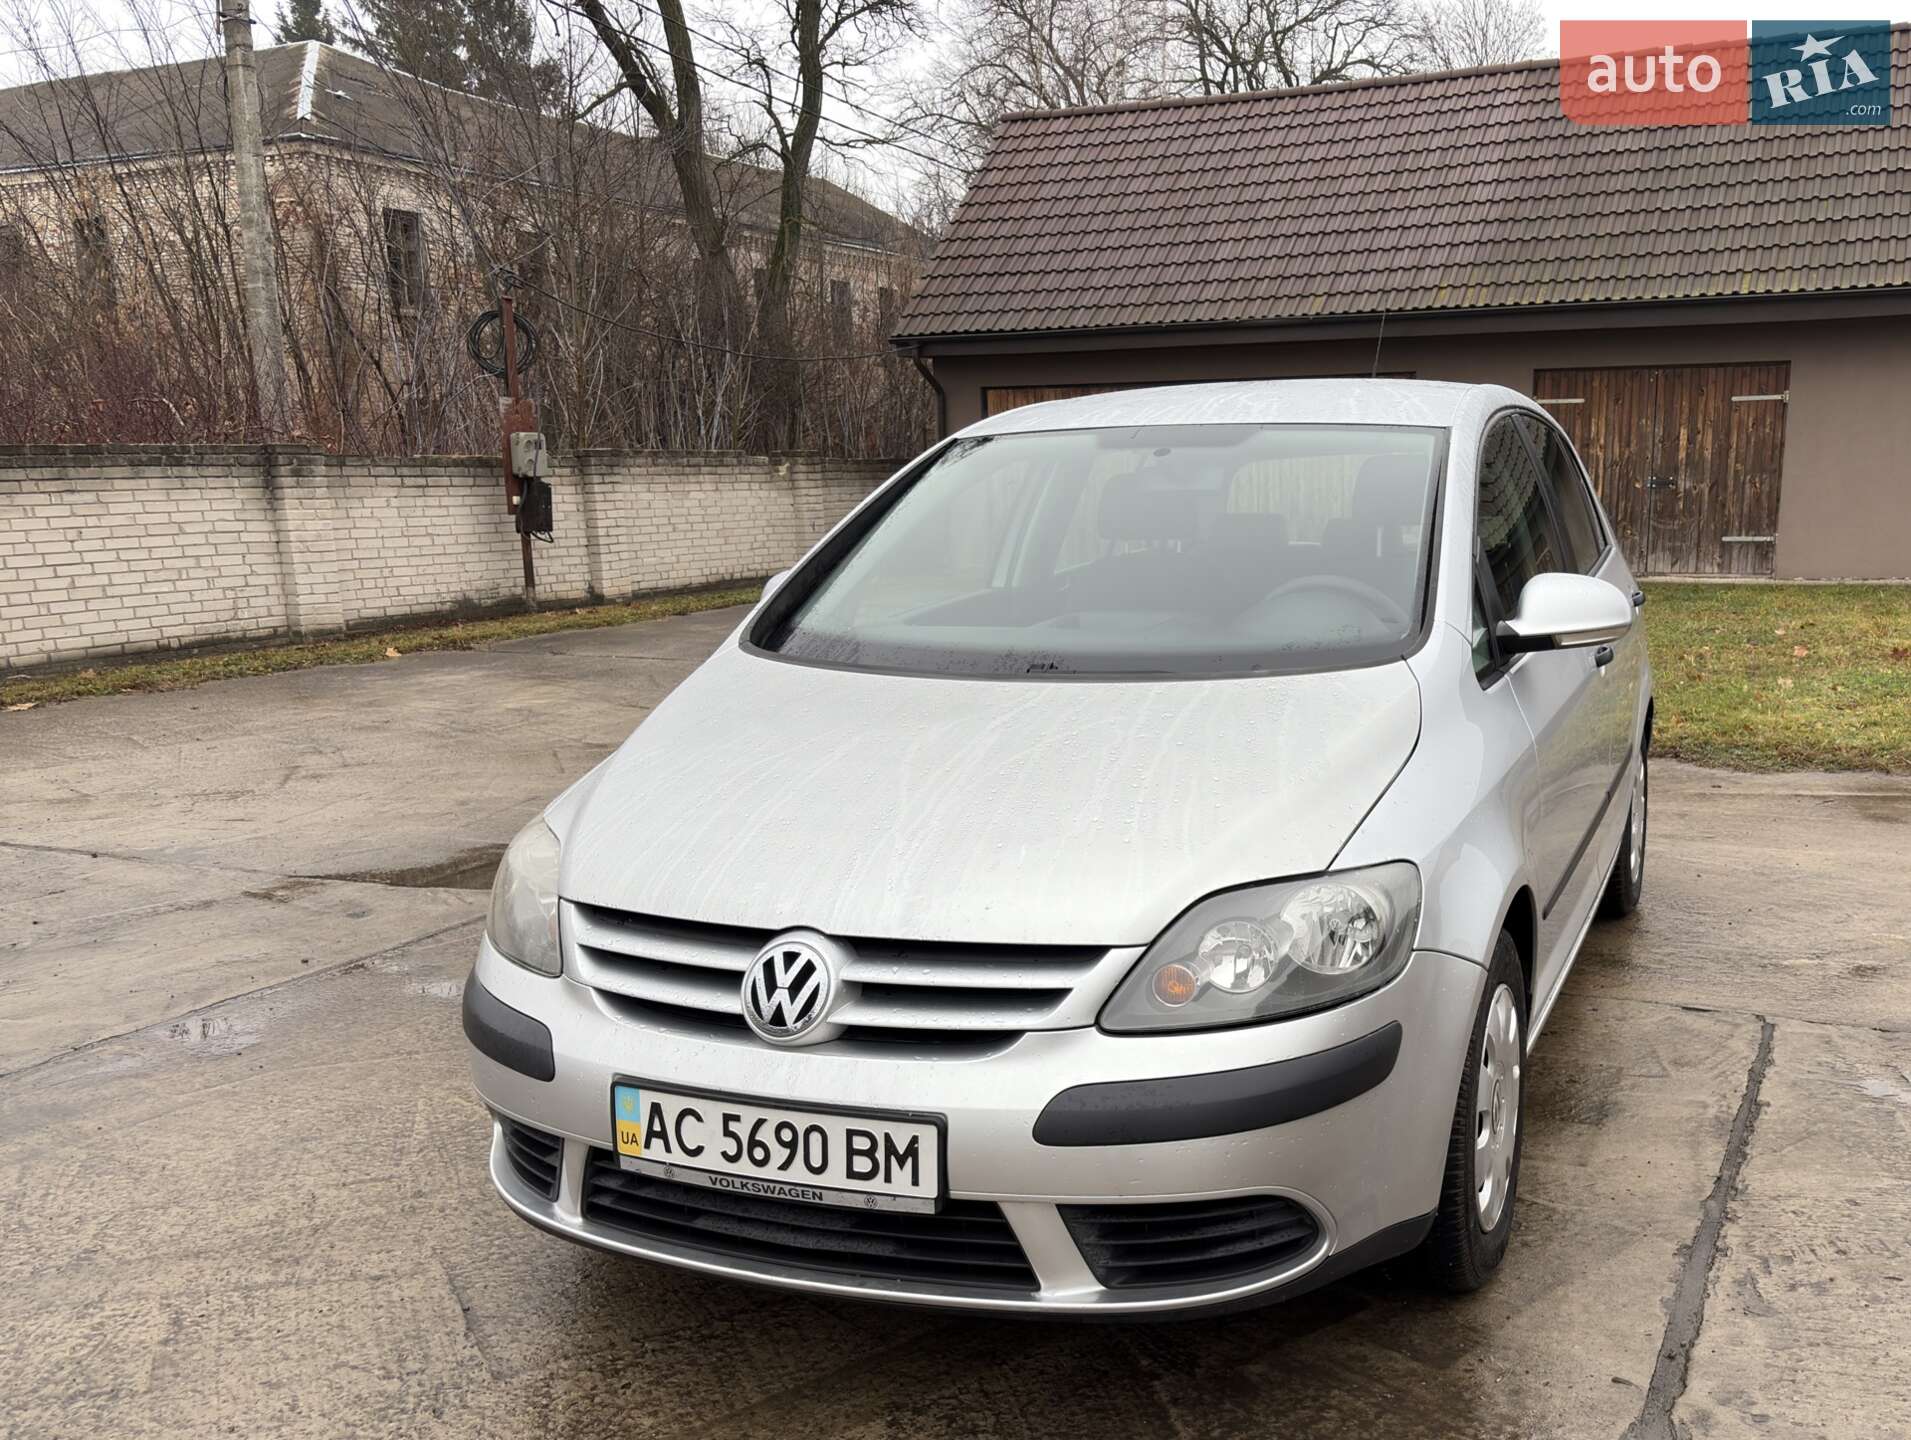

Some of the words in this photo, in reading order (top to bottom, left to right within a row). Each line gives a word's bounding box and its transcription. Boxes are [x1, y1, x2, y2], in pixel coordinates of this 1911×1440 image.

[747, 943, 827, 1033] VW
[620, 1130, 639, 1147] UA
[643, 1101, 705, 1158] AC
[720, 1112, 829, 1176] 5690
[845, 1127, 920, 1187] BM
[708, 1175, 824, 1202] VOLKSWAGEN
